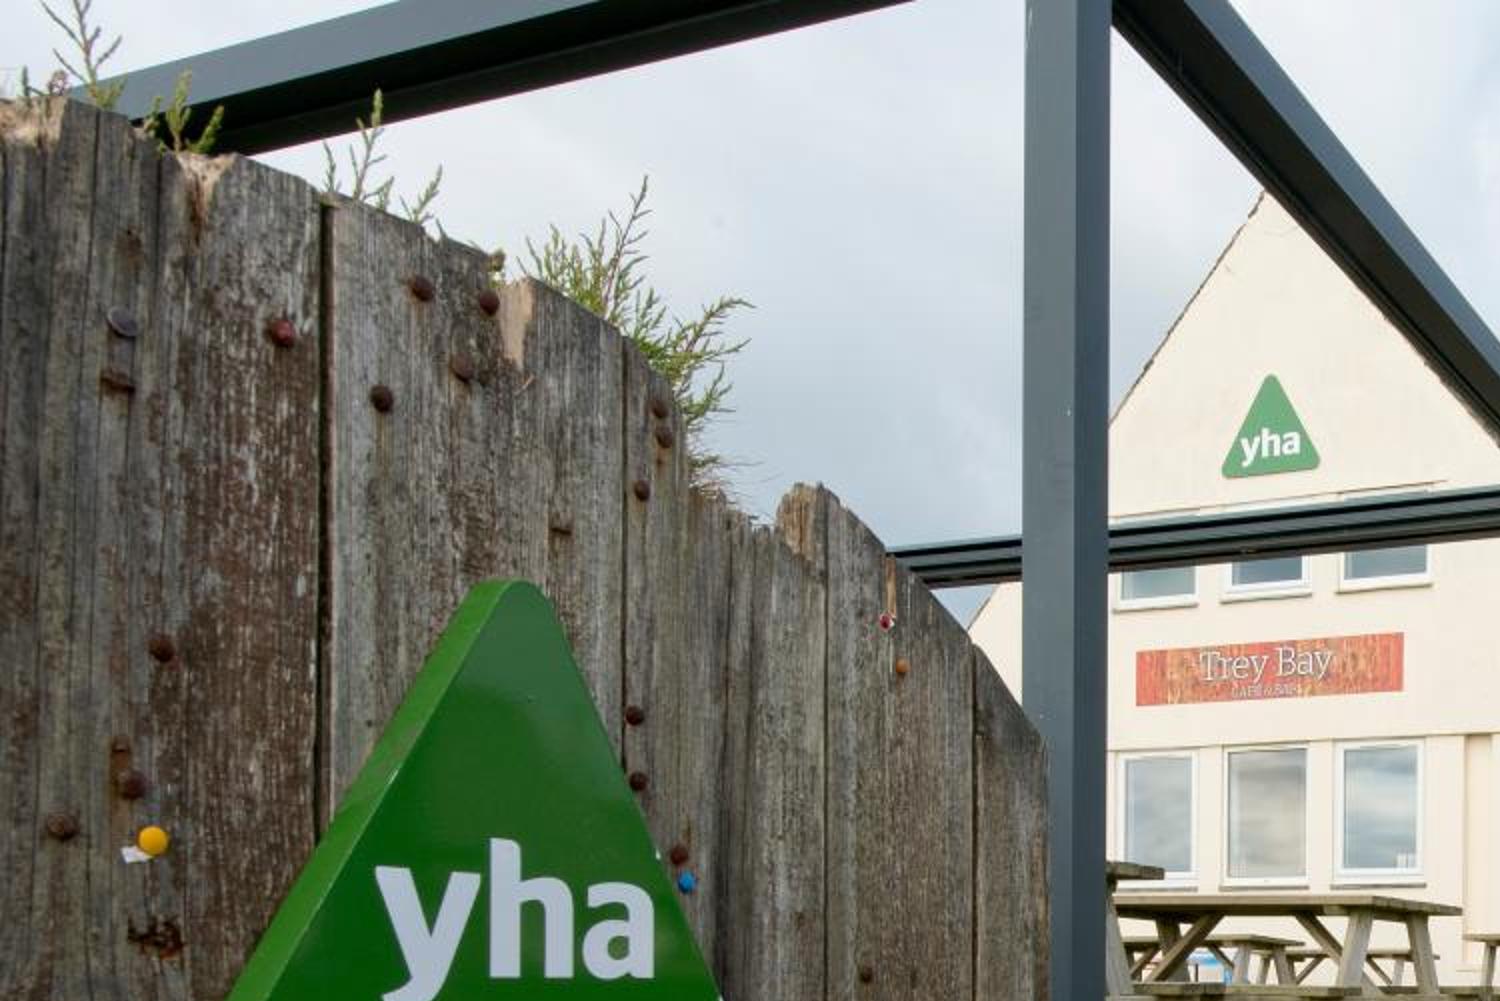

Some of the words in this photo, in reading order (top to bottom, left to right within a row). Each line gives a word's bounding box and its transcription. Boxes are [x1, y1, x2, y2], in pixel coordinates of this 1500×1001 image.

[1241, 427, 1301, 467] yha
[1199, 650, 1269, 683] Trey
[1274, 646, 1333, 681] Bay
